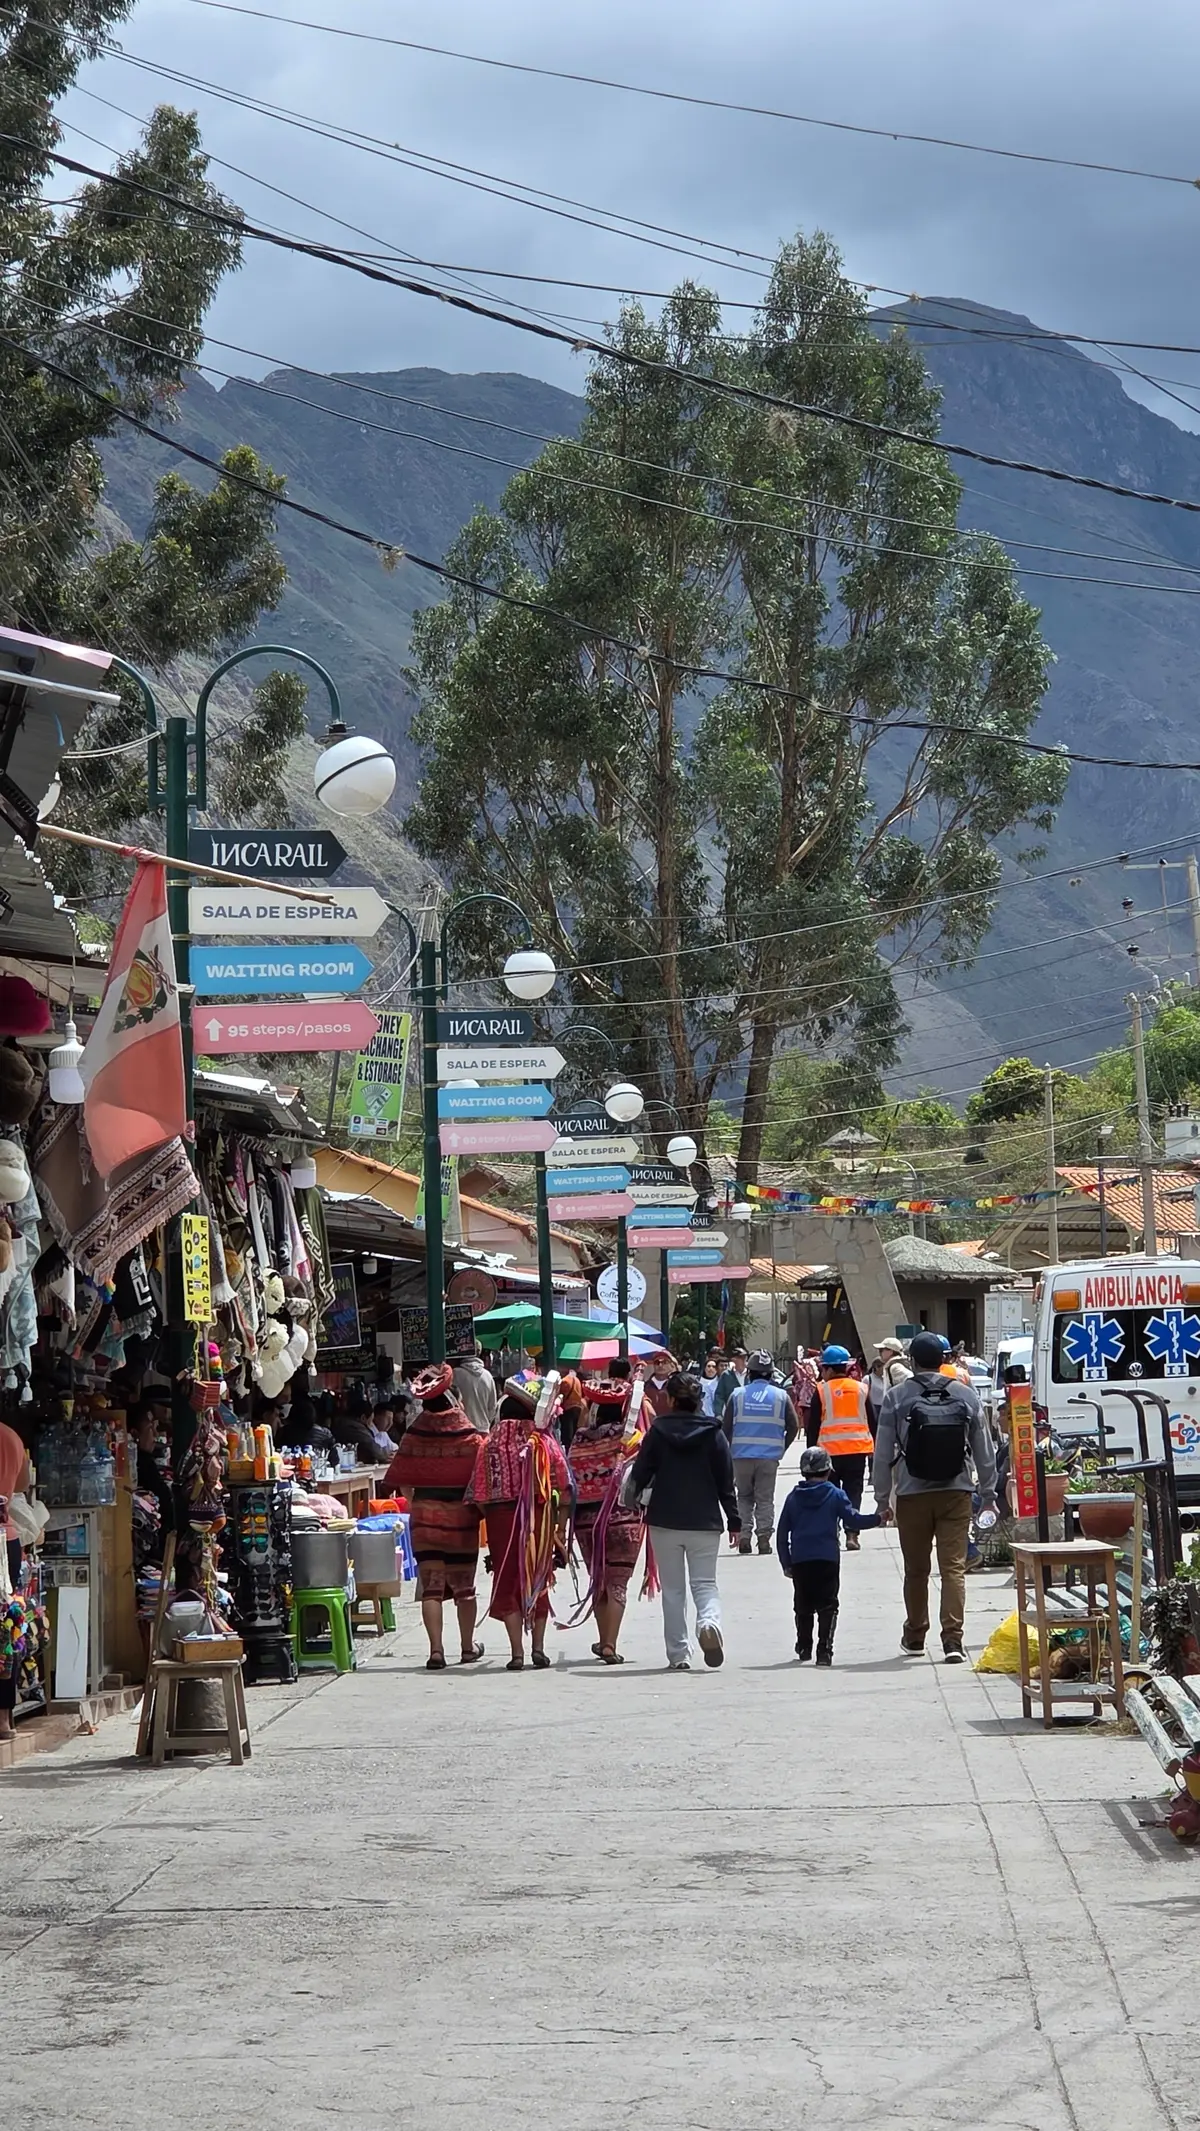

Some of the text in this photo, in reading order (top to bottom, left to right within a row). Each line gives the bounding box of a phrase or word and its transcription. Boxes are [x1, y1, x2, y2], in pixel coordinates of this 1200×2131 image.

[202, 905, 358, 920] SALA DE ESPERA
[205, 962, 354, 979] WAITING ROOM
[227, 1021, 352, 1039] 95 steps/pasos
[374, 1013, 403, 1035] ONEY
[364, 1059, 403, 1085] ESTORAGE
[447, 1059, 547, 1070] SALA DE ESPERA
[448, 1095, 543, 1108] WAITING ROOM
[552, 1146, 627, 1158] SALA DE ESPERA
[553, 1174, 624, 1186] WAITING ROOM
[183, 1218, 210, 1317] MONEY EXCHANGE
[1085, 1274, 1184, 1309] AMBULANCIA
